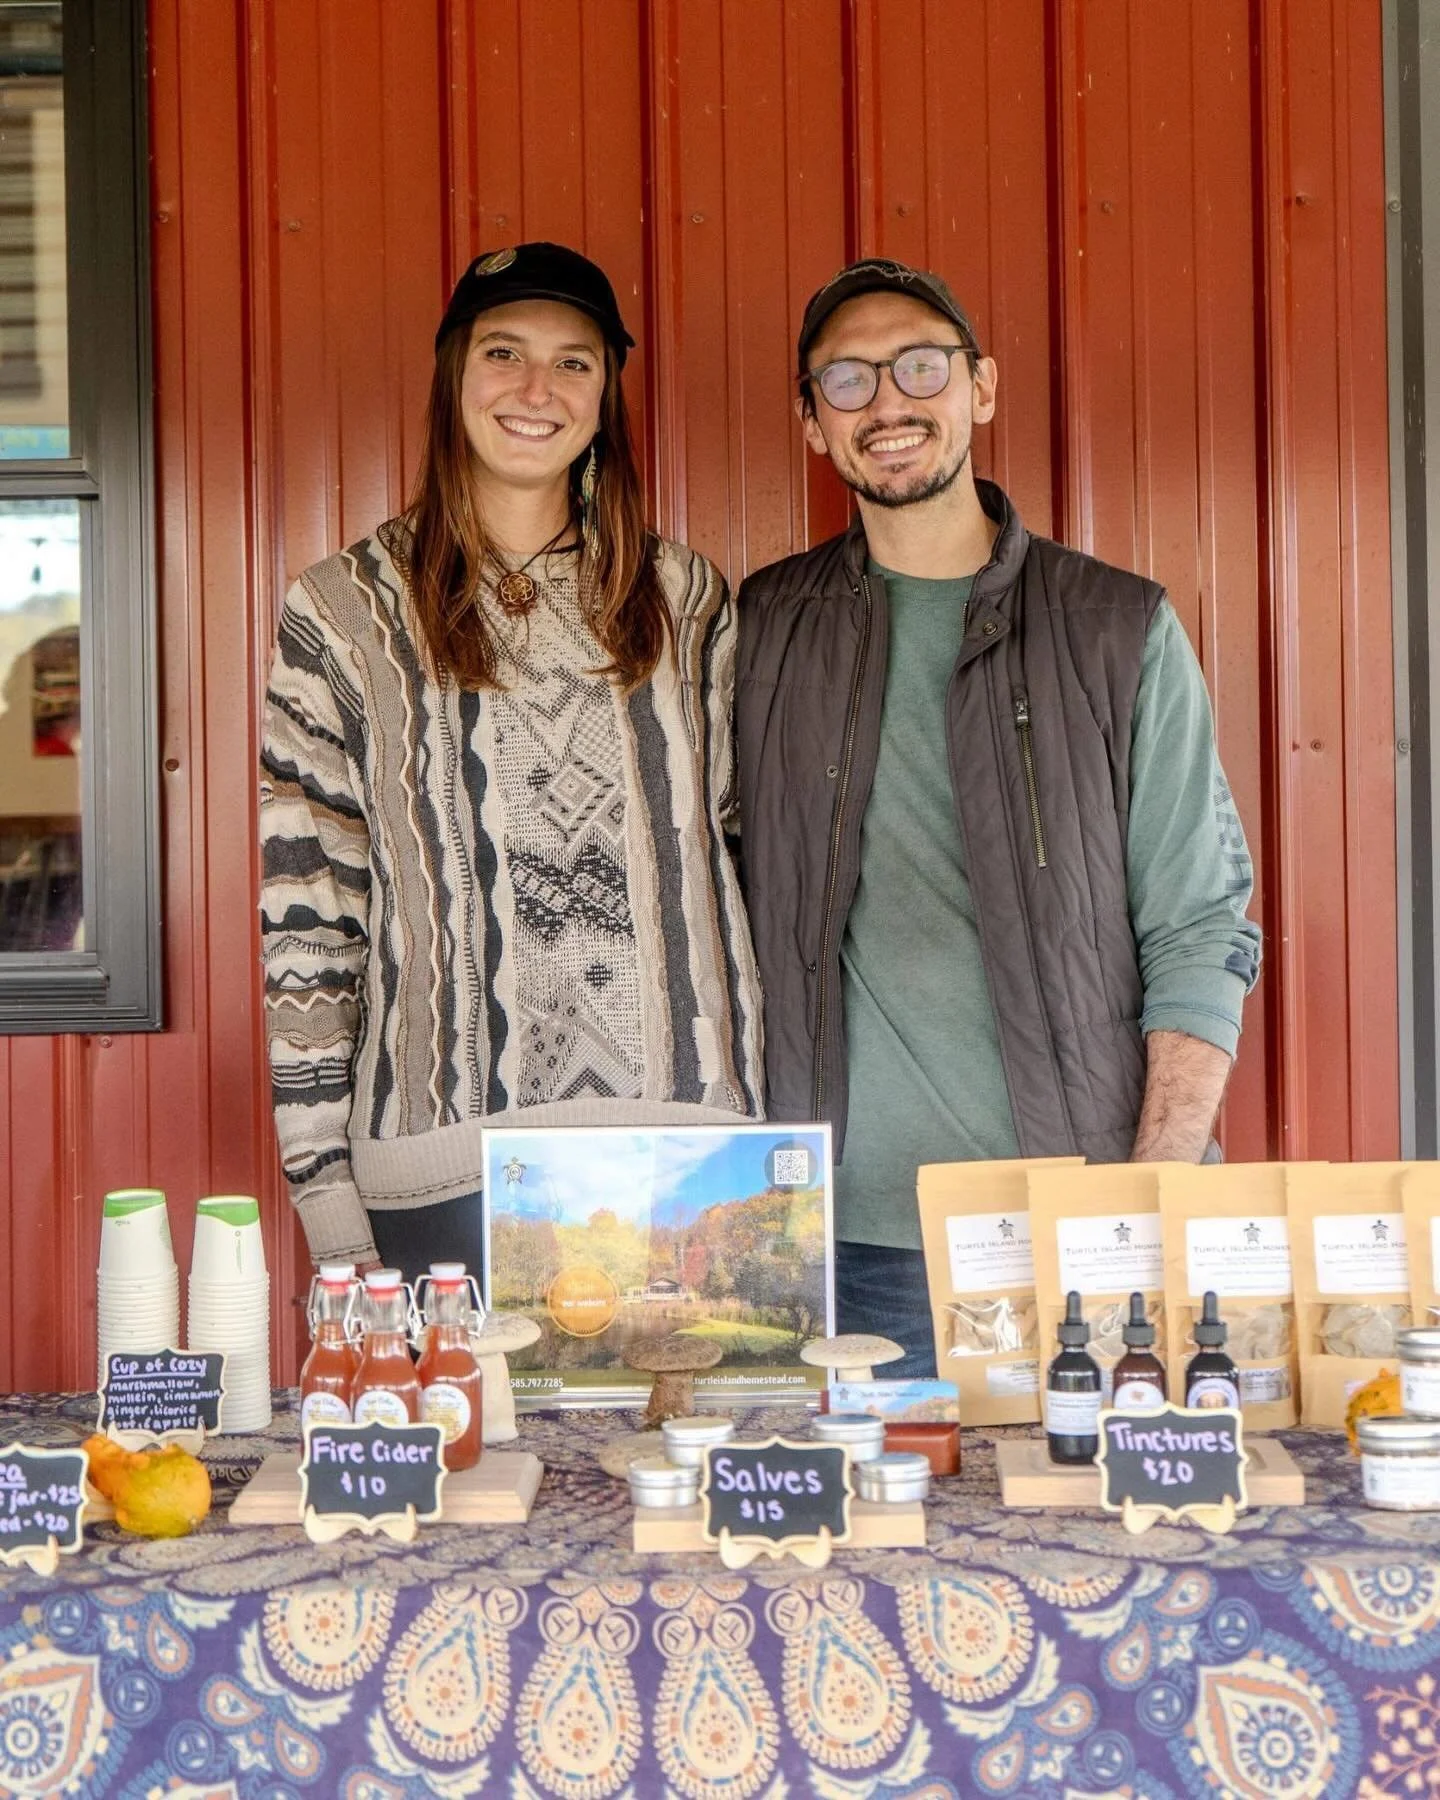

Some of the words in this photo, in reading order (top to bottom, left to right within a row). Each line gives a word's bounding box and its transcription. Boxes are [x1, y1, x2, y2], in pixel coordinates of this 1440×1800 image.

[111, 1357, 139, 1376] Cup
[145, 1357, 164, 1372] of
[169, 1356, 207, 1377] Cozy
[164, 1389, 220, 1401] cinnamon
[510, 1377, 564, 1388] 585.797.7285
[312, 1435, 365, 1464] Fire
[371, 1439, 433, 1463] Cider
[1106, 1422, 1236, 1453] Tinctures
[715, 1457, 823, 1495] Salves
[1142, 1456, 1194, 1485] $20
[340, 1471, 386, 1499] $10
[740, 1498, 785, 1523] $15
